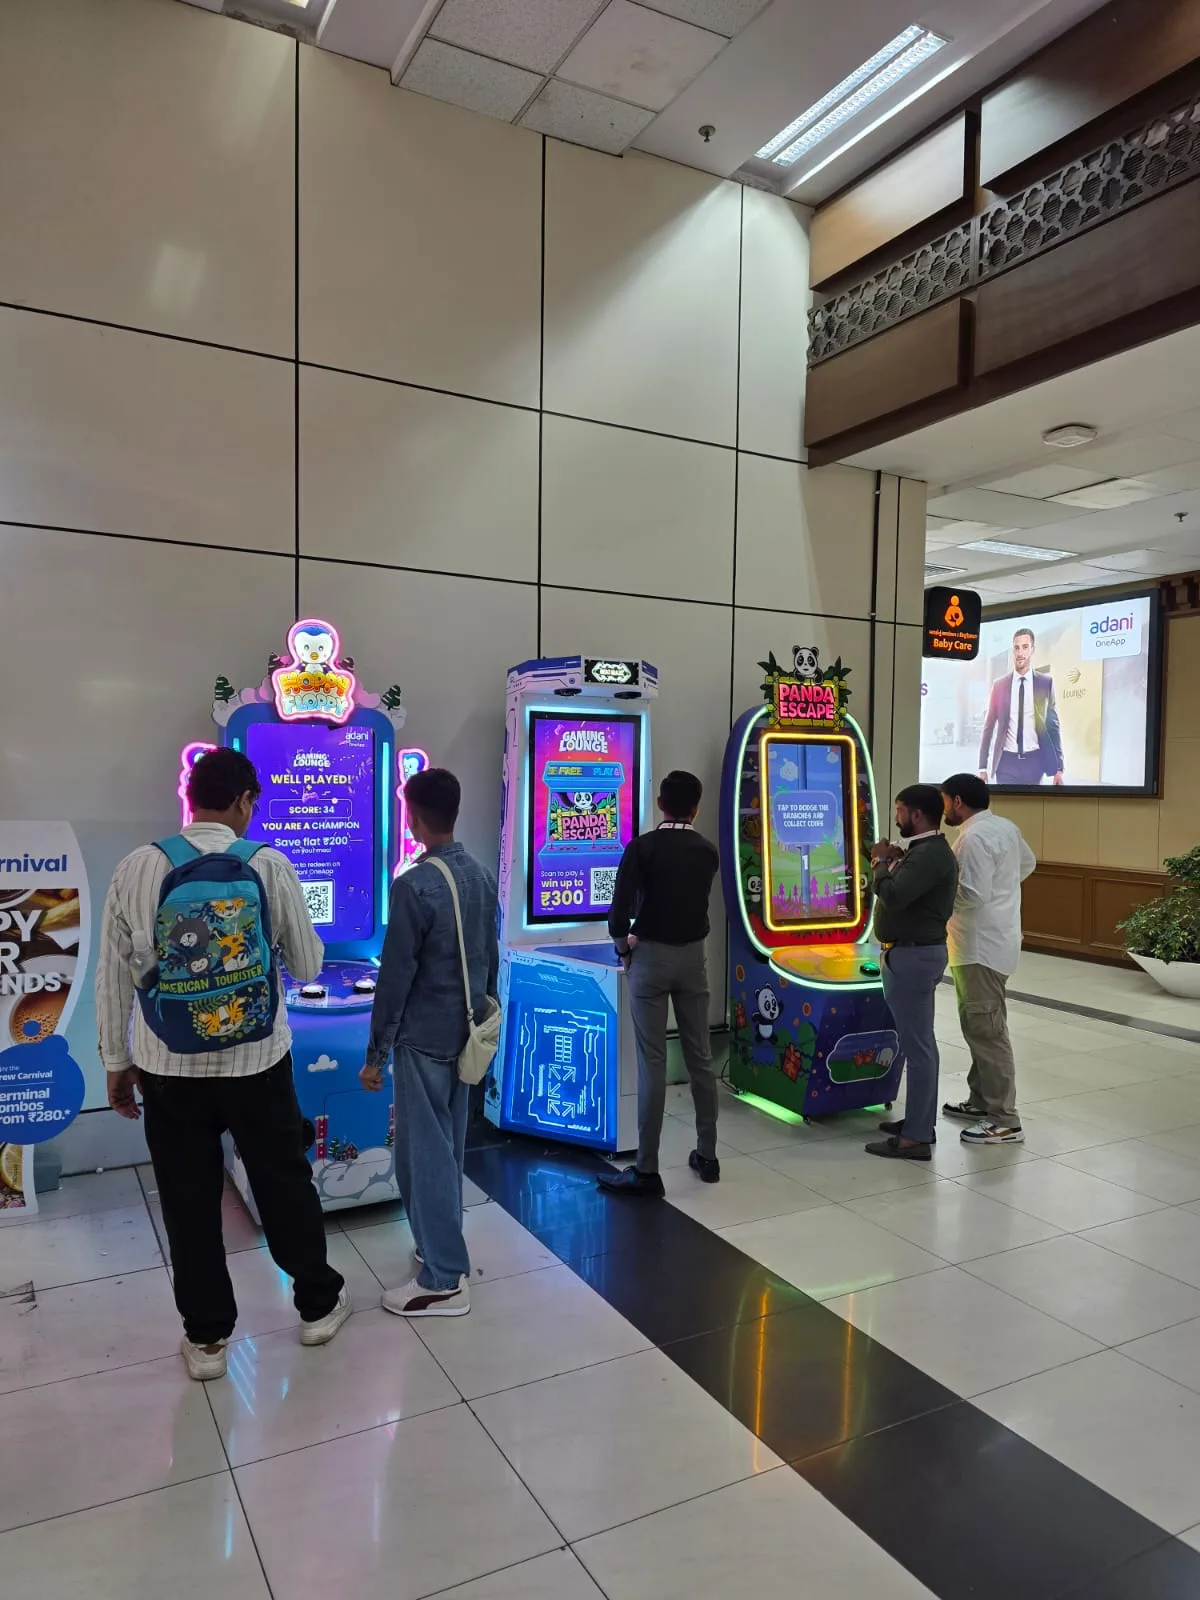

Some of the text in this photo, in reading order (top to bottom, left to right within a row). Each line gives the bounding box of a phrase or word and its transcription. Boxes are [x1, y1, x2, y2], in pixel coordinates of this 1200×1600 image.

[1089, 612, 1134, 635] adani
[933, 638, 973, 651] Baby Care
[1095, 638, 1126, 649] OneApp
[278, 671, 350, 697] HOPPY
[779, 683, 835, 703] PANDA
[282, 693, 349, 716] FLOPPY
[779, 701, 835, 719] ESCAPE
[345, 731, 369, 741] adani
[562, 730, 606, 743] GAMING
[559, 740, 609, 754] LOUNGE
[295, 753, 328, 761] GAMING
[293, 759, 331, 768] LOUNGE
[593, 767, 614, 776] PLAY
[270, 774, 352, 785] WELL PLAYED!
[288, 805, 335, 815] SCORE: 34
[778, 804, 789, 812] TAP
[790, 804, 798, 812] TO
[799, 804, 818, 812] DODGE
[262, 820, 360, 831] YOU ARE A CHAMPION
[562, 812, 607, 830] PANDA
[784, 820, 806, 828] COLLECT
[562, 826, 608, 841] ESCAPE
[274, 836, 348, 847] Save flat ₹200
[801, 854, 809, 870] 1
[541, 870, 557, 878] Scan
[541, 878, 584, 890] win up to
[159, 964, 262, 994] AMERICAN TOURISTER
[17, 1069, 53, 1080] Carnival
[0, 1087, 50, 1101] erminal
[0, 1101, 44, 1113] ombos
